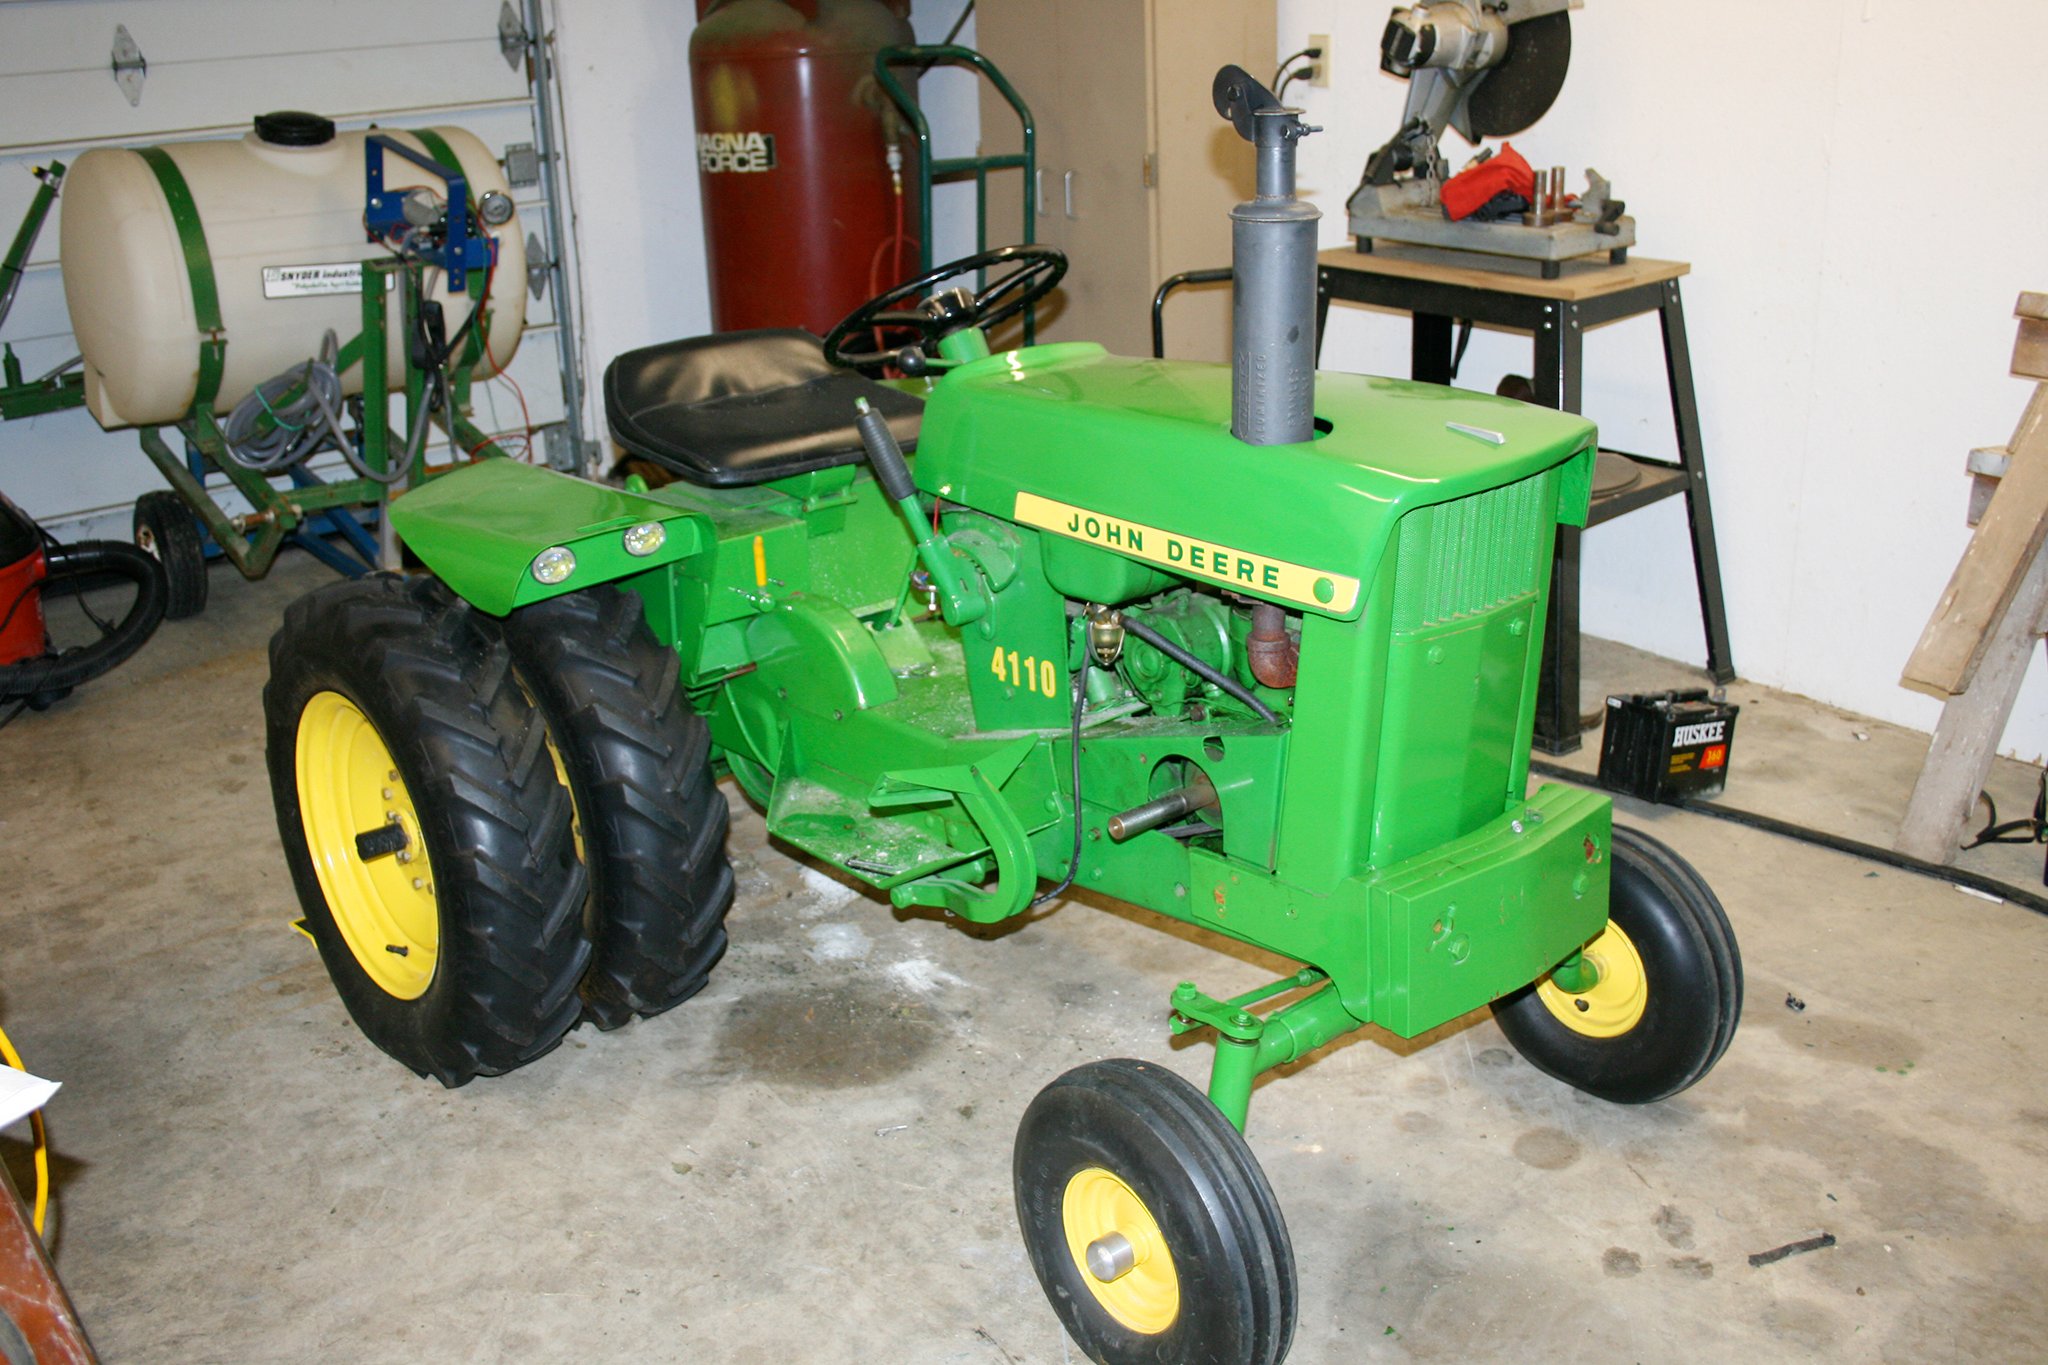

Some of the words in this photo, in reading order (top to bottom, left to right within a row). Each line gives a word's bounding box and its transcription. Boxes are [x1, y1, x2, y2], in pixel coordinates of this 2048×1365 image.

[281, 269, 320, 281] SNYDER
[1067, 513, 1144, 551] JOHN
[1167, 539, 1280, 589] DEERE
[991, 646, 1056, 698] 4110
[1672, 720, 1726, 748] HUSKEE
